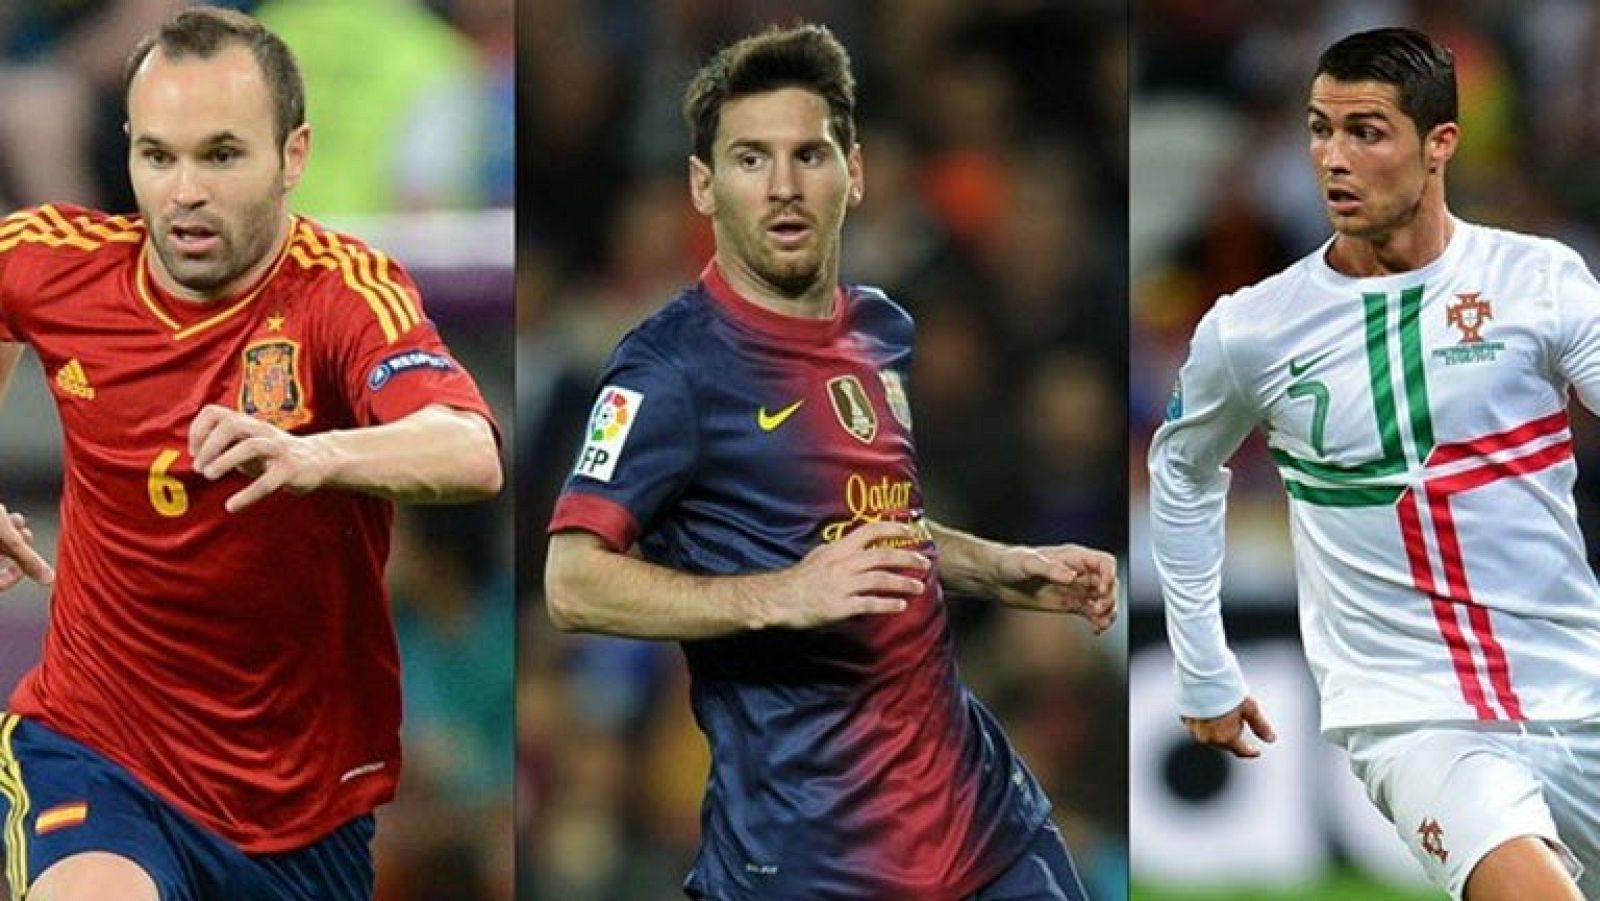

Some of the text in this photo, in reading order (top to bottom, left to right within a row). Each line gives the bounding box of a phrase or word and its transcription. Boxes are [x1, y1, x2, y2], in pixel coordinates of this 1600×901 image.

[1286, 381, 1330, 458] 7
[148, 448, 189, 517] 6
[847, 473, 912, 523] Qatar
